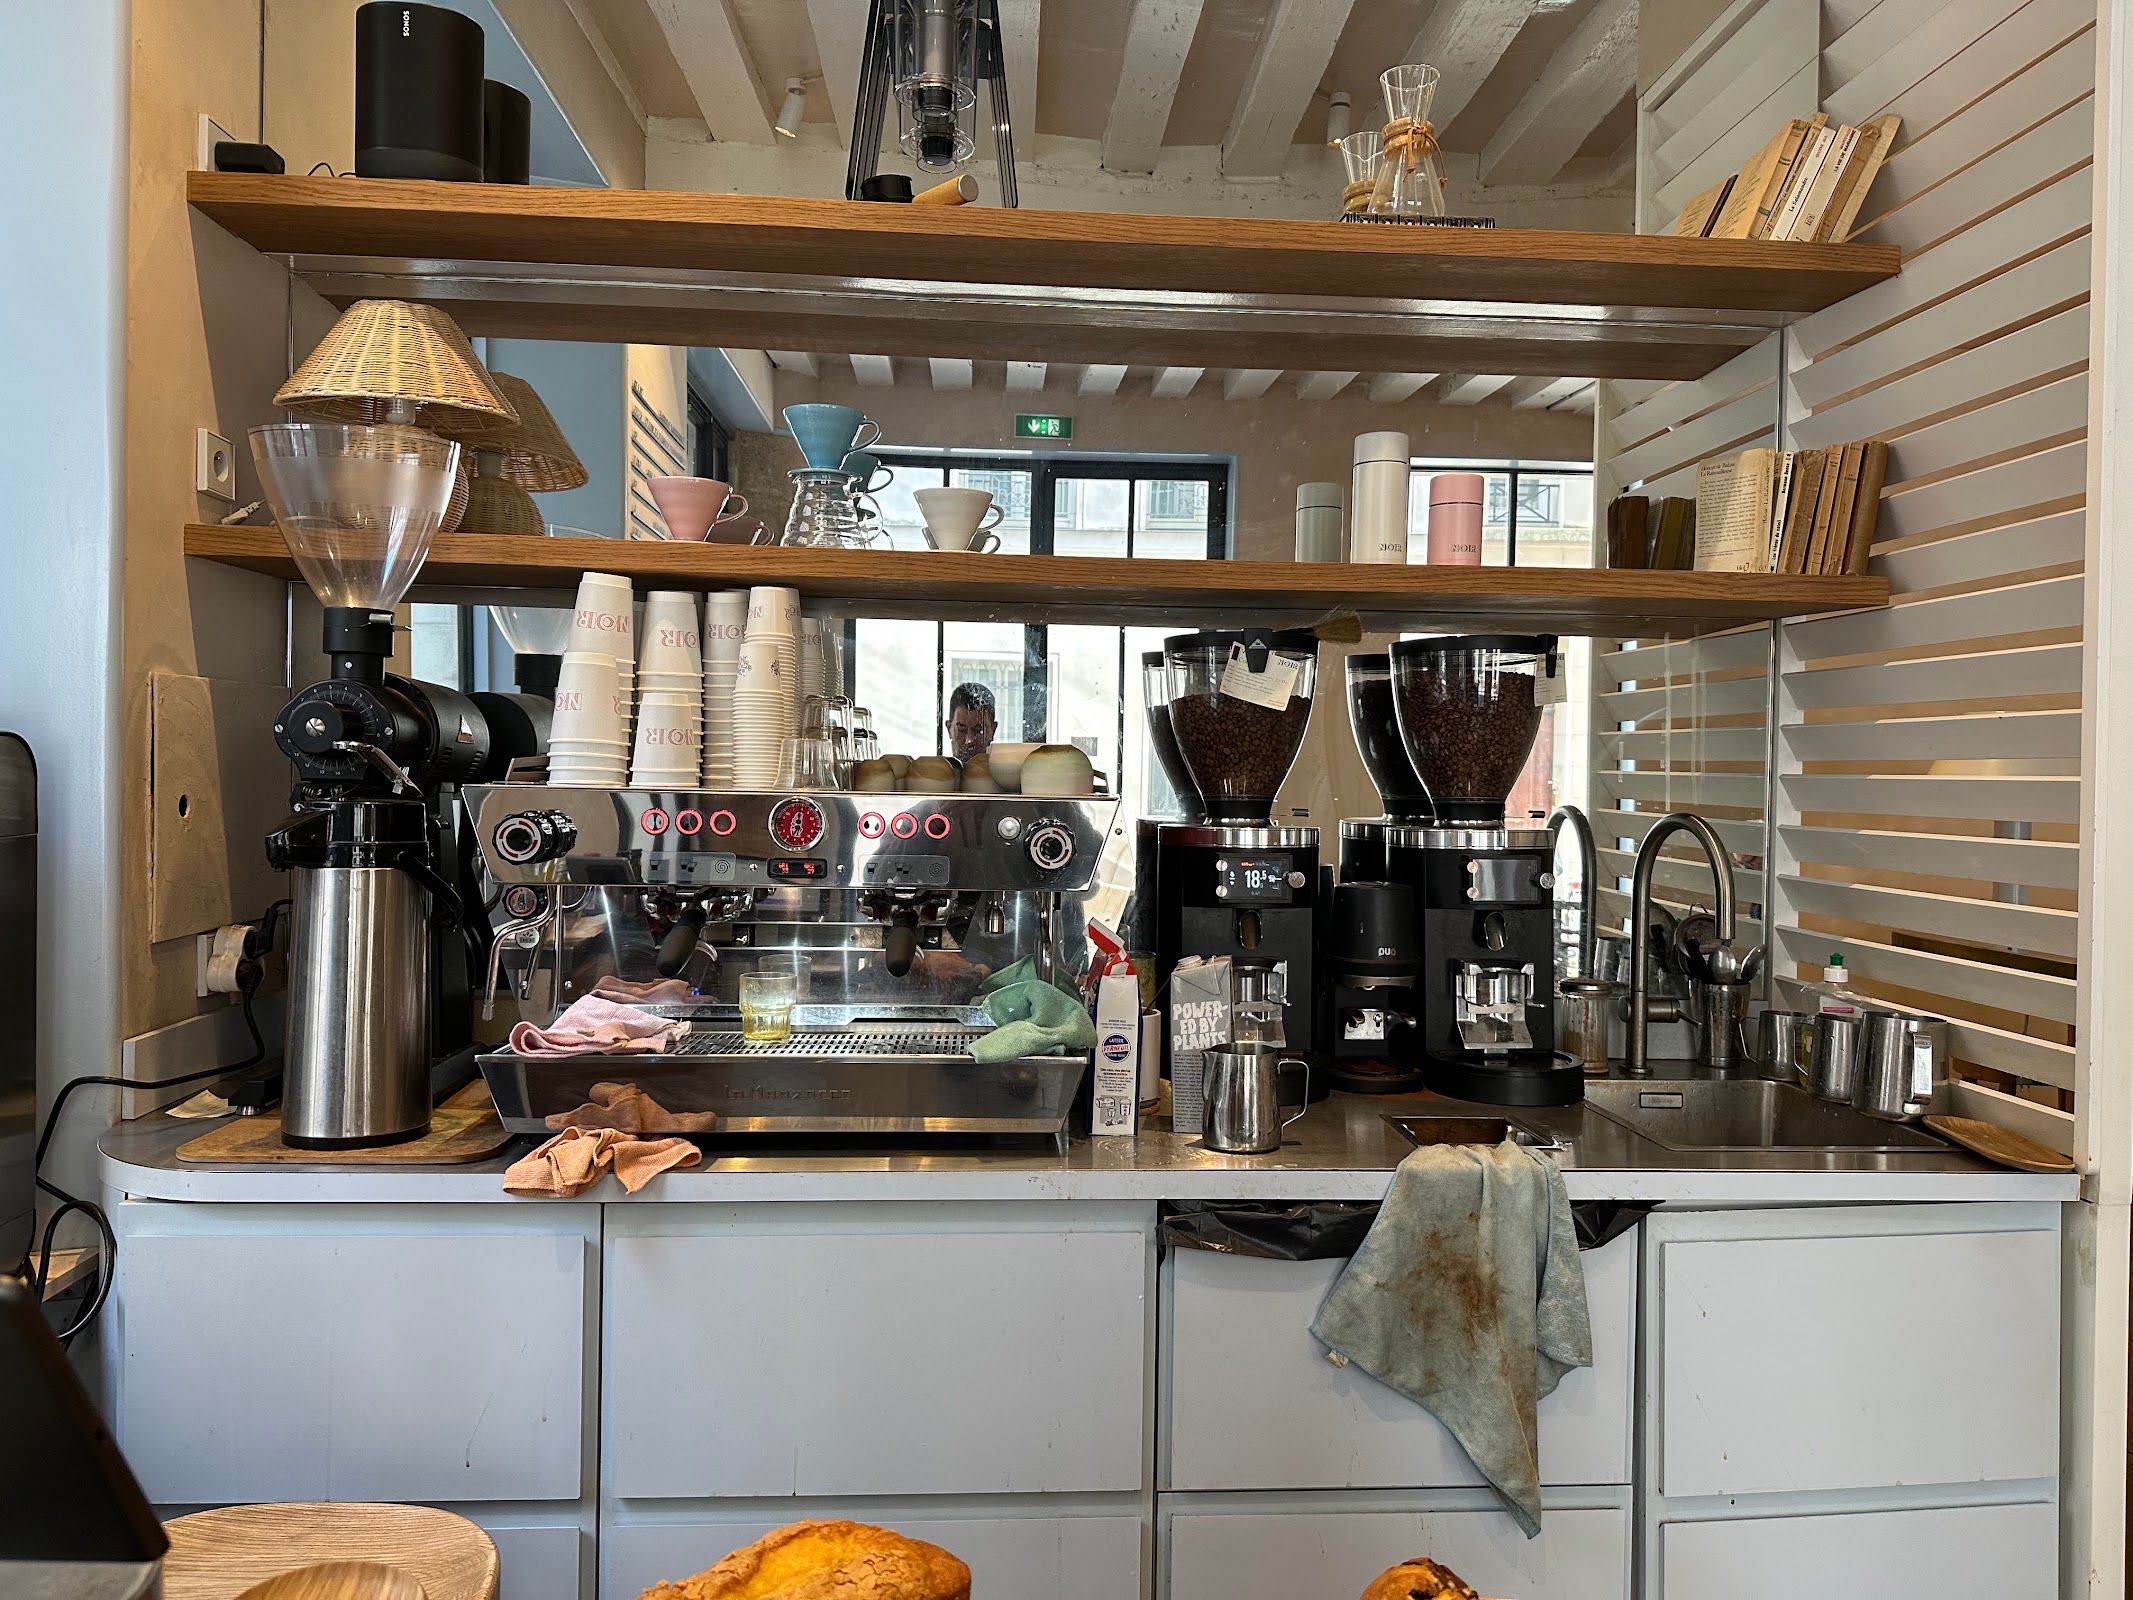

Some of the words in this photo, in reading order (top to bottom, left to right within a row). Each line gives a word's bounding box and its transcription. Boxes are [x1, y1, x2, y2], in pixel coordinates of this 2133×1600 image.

[1793, 177, 1809, 205] Salamandre
[1379, 543, 1402, 553] NOIR
[1451, 544, 1477, 553] NOIR
[576, 609, 631, 634] NOIR
[1173, 1000, 1229, 1020] POWER-
[1180, 1019, 1197, 1035] ED
[1199, 1016, 1219, 1034] BY
[1173, 1030, 1227, 1051] PLANTS
